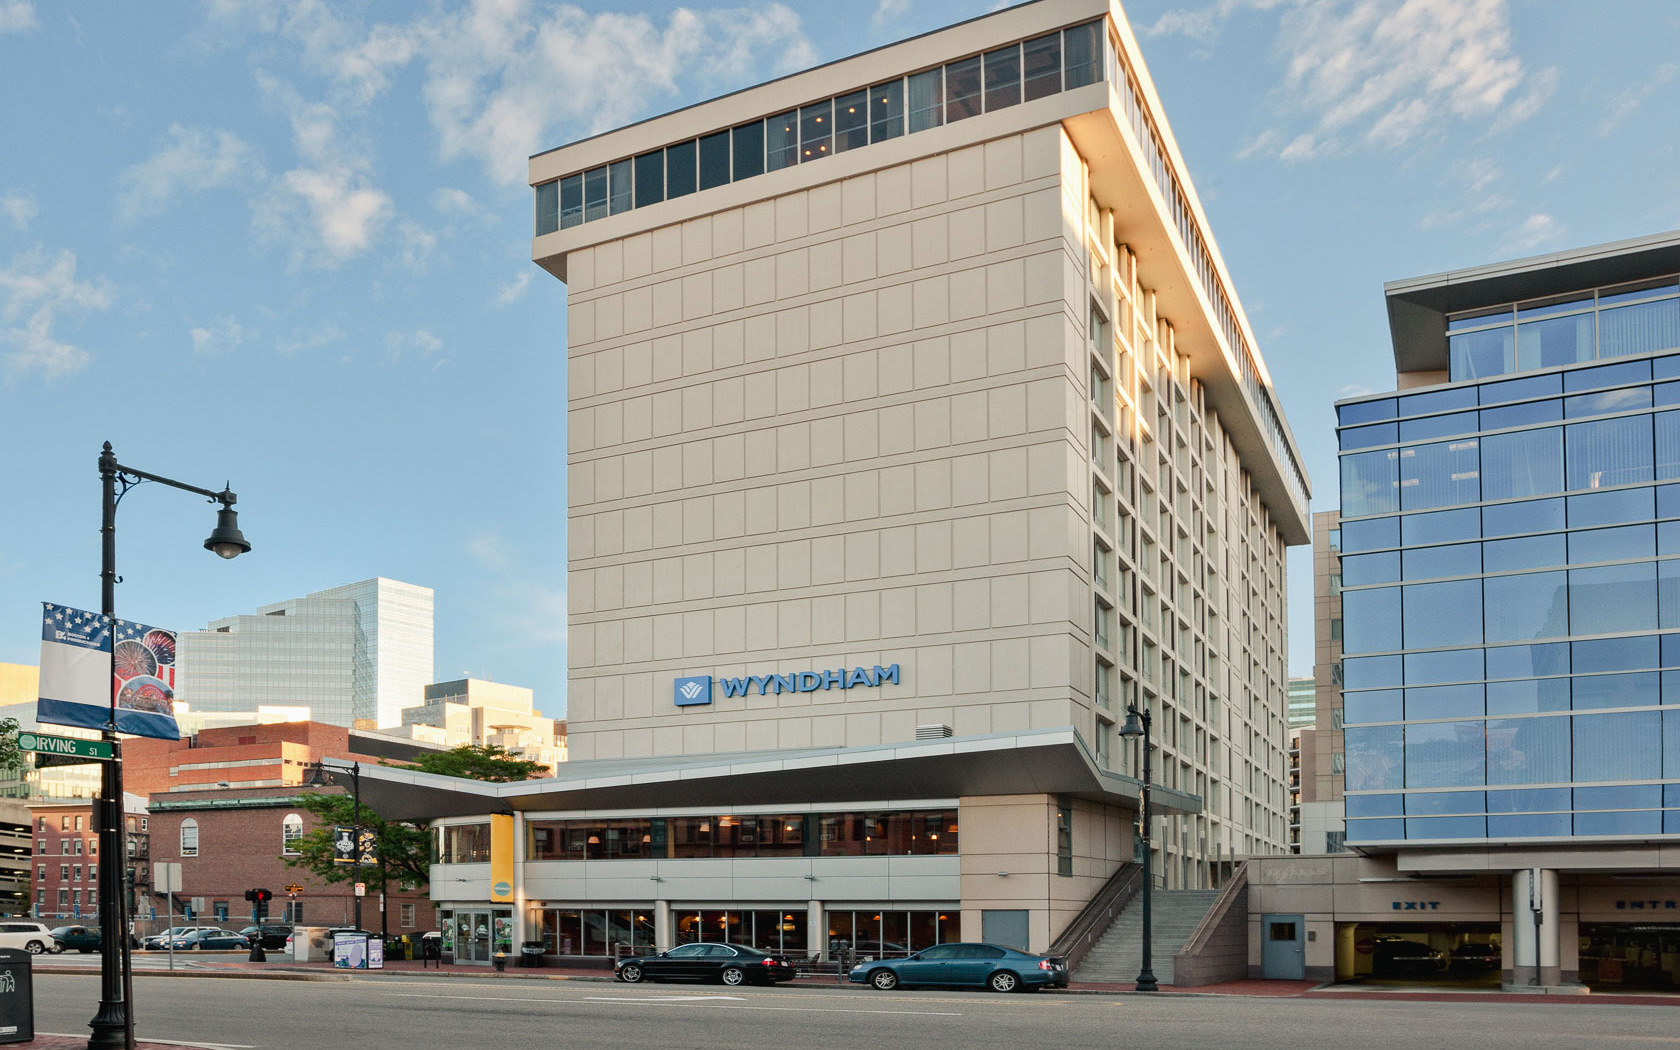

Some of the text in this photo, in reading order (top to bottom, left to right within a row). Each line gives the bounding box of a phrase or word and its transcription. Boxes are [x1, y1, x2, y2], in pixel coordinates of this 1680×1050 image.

[720, 663, 899, 698] WYNDHAM
[36, 736, 76, 753] IRVING
[1392, 901, 1441, 910] EXIT
[1616, 900, 1677, 909] ENTR
